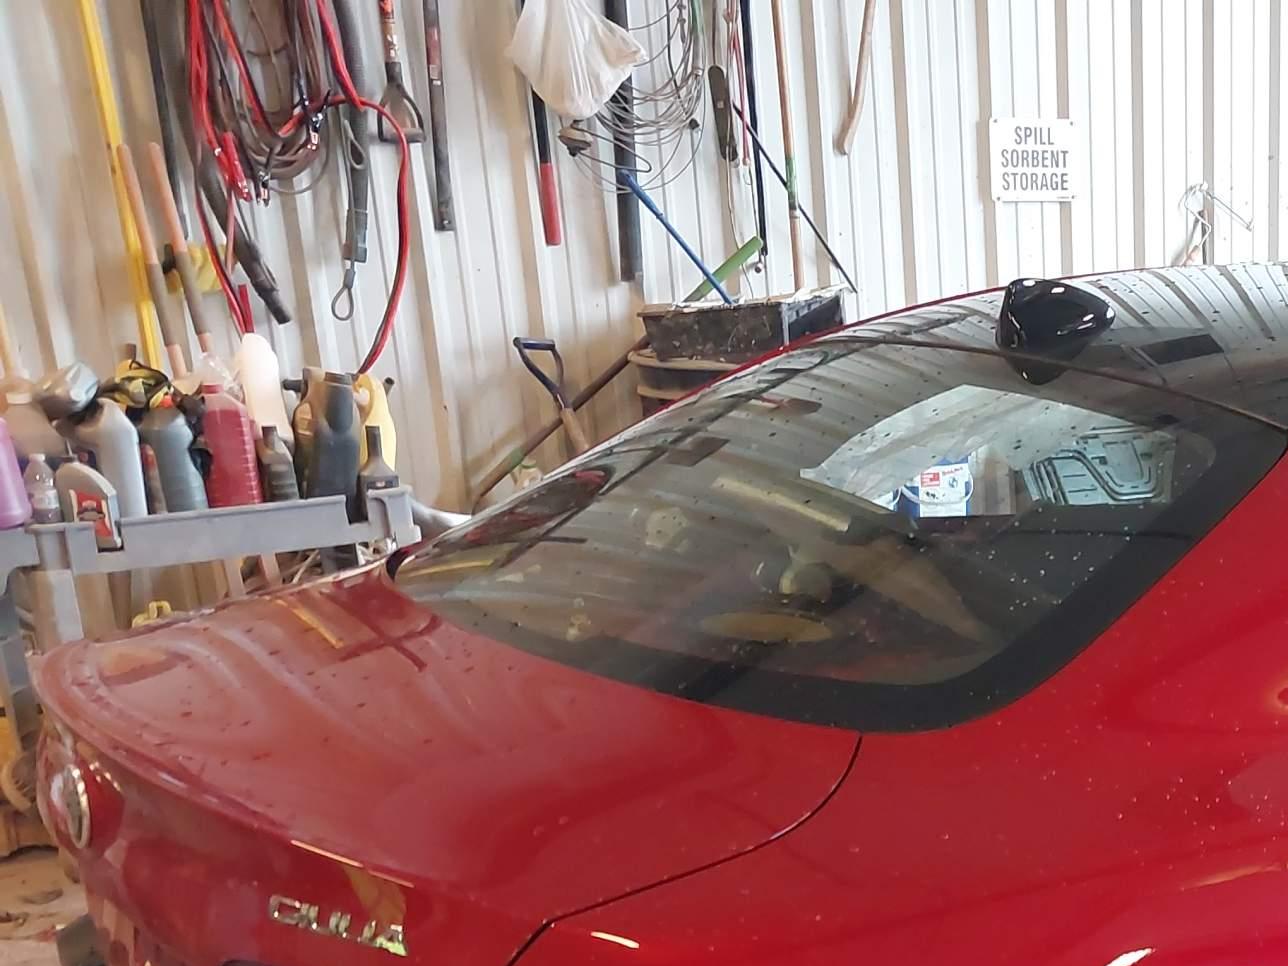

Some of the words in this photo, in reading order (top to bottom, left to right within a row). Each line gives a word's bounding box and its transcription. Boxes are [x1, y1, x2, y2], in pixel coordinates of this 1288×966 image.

[1014, 126, 1055, 146] SPILL
[1001, 149, 1070, 168] SORBENT
[1002, 172, 1069, 191] STORAGE
